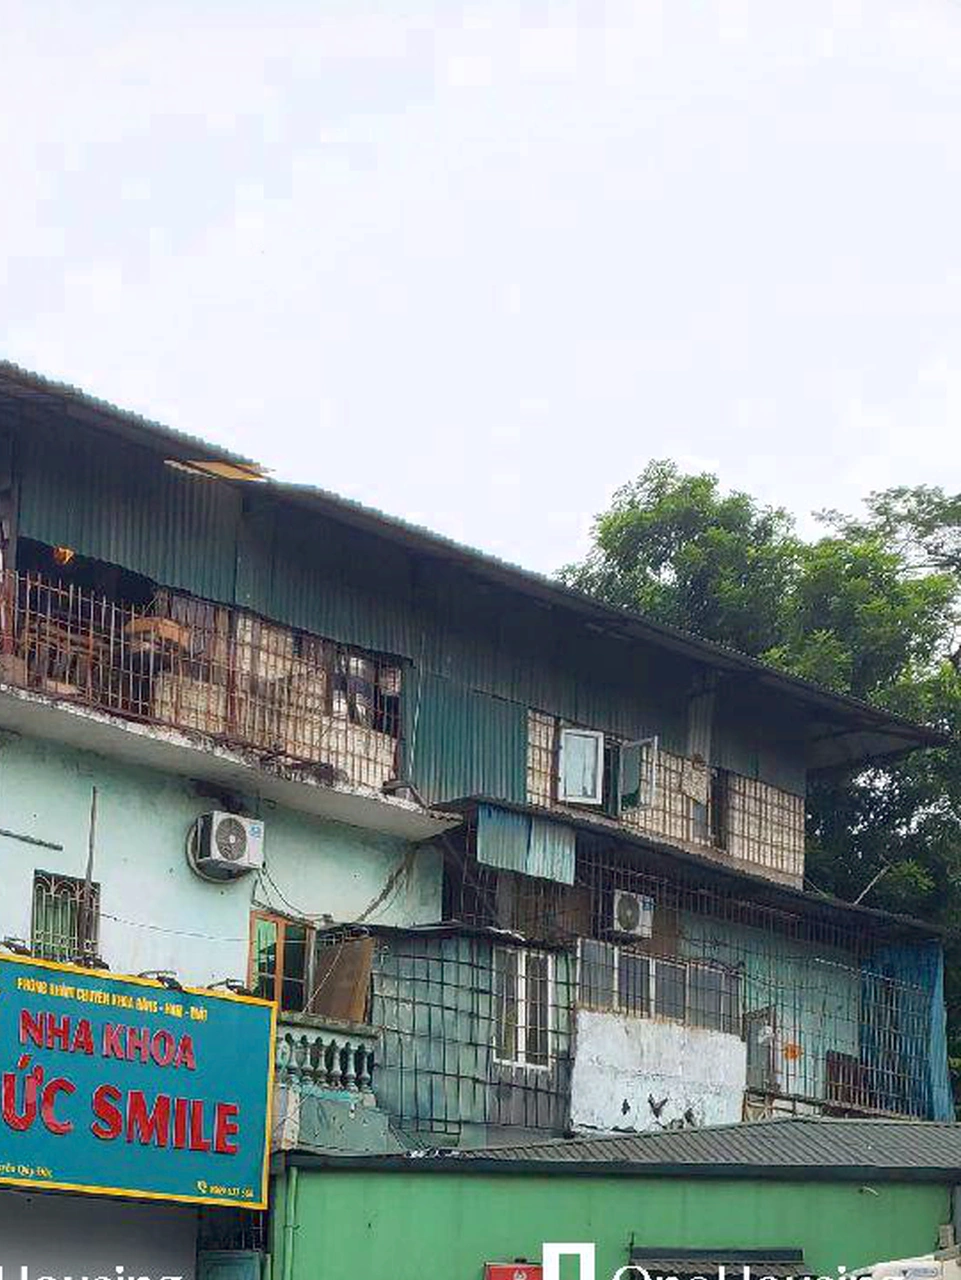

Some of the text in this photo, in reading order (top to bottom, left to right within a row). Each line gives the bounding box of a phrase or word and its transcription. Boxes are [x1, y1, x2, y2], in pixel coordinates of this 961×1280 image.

[18, 1008, 197, 1071] NHA KHOA
[91, 1081, 240, 1155] SMILE
